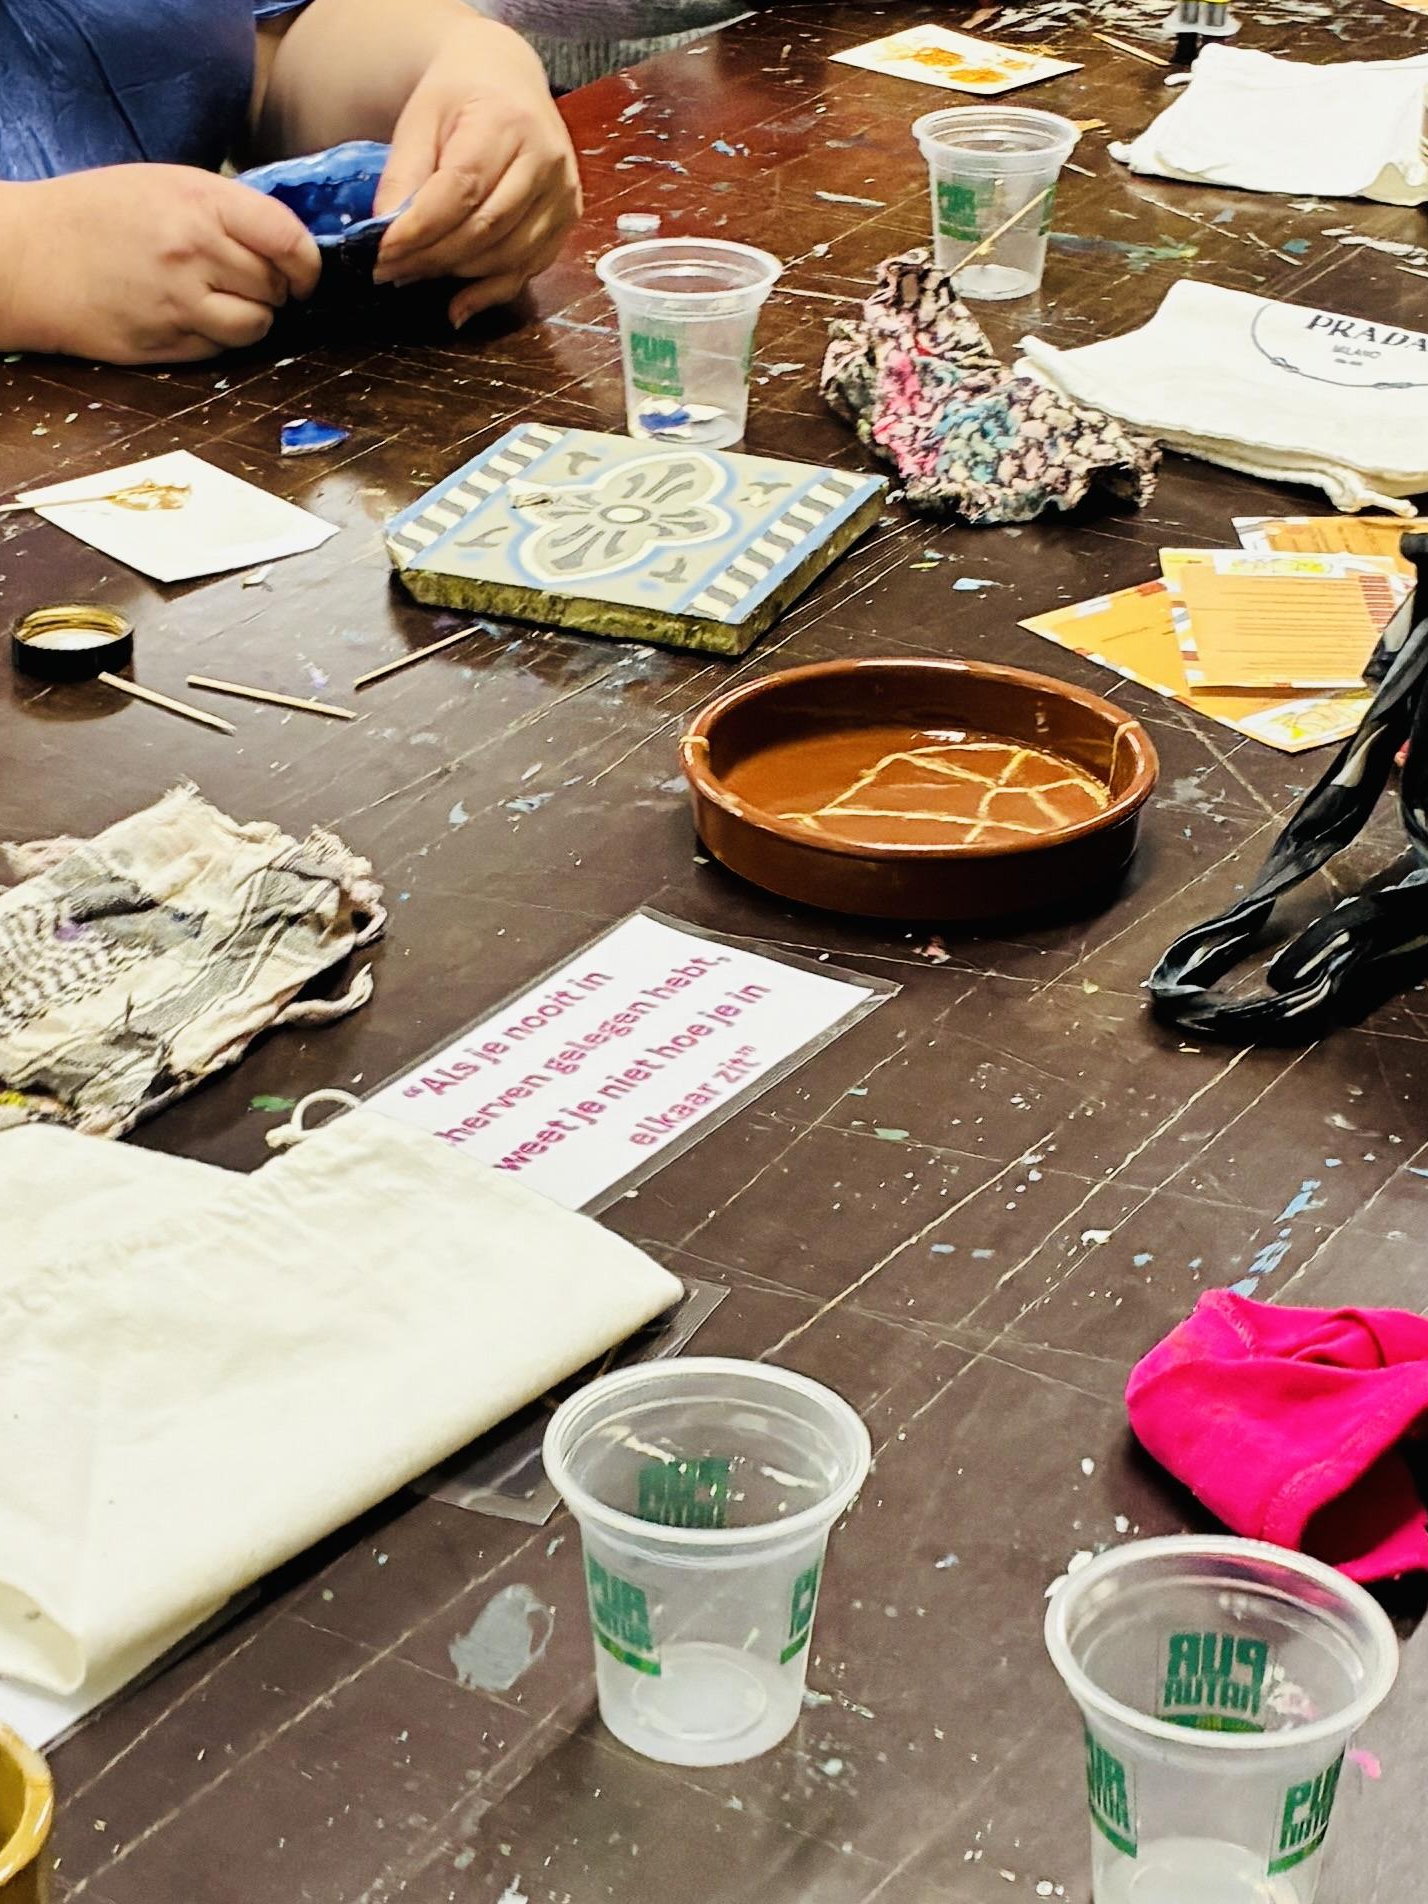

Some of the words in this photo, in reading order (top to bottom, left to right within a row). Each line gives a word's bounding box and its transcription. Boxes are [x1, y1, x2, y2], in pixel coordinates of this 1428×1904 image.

[1306, 314, 1428, 352] PRADA
[463, 1041, 510, 1065] je
[502, 990, 587, 1041] nooit
[566, 972, 614, 992] in
[543, 1001, 660, 1075] gelegen
[639, 956, 732, 1000] hebt,
[492, 1120, 580, 1171] weet
[558, 1100, 607, 1126] je
[596, 1059, 666, 1100] niet
[644, 1024, 714, 1059] hoe
[696, 1004, 743, 1028] je
[724, 984, 772, 1004] in
[628, 1082, 722, 1145] elkaar
